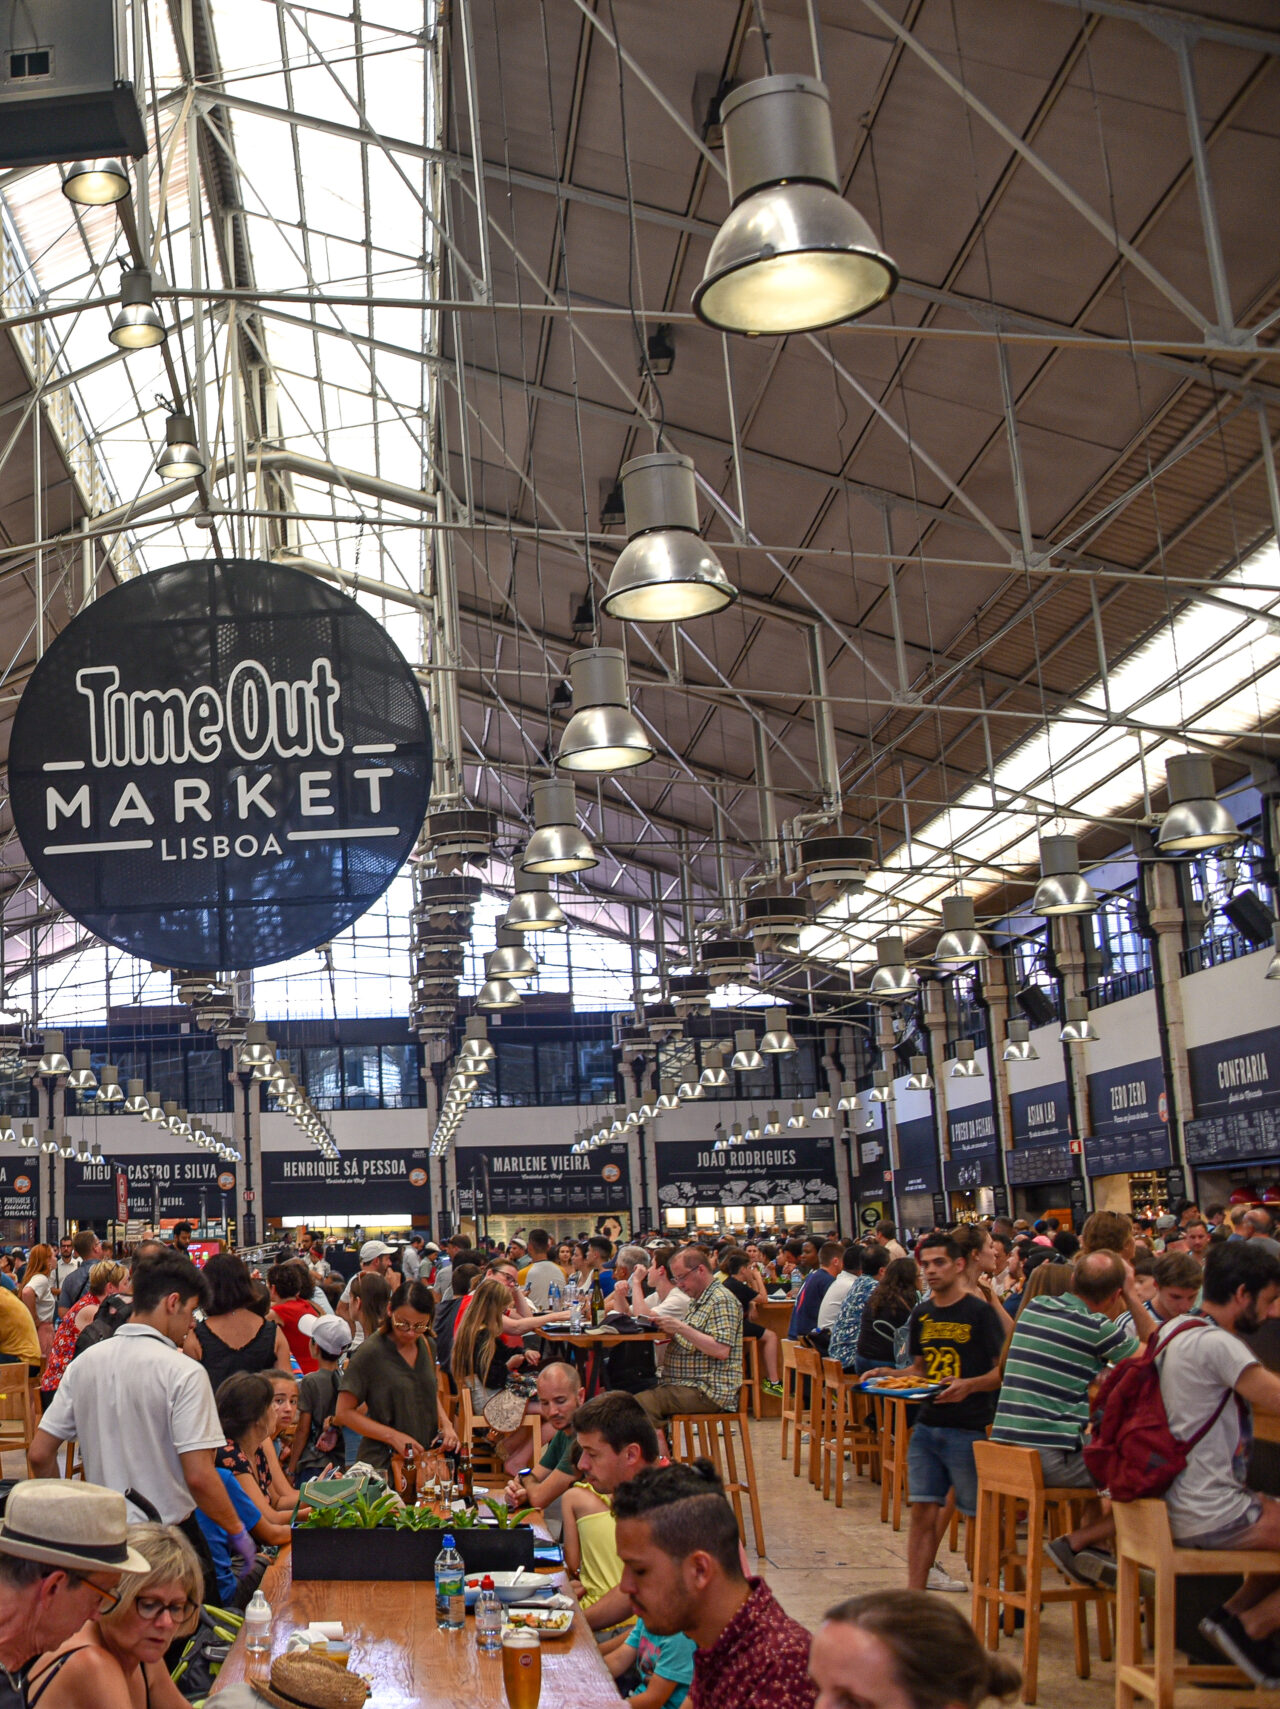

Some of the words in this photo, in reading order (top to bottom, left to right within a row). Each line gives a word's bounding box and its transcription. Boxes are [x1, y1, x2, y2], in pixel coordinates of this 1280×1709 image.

[47, 767, 394, 831] MARKET
[161, 832, 284, 862] LISBOA
[1217, 1052, 1269, 1089] CONFRARIA
[1110, 1085, 1128, 1110] ZERO
[1128, 1081, 1147, 1107] ZERO
[1044, 1101, 1056, 1124] LAB
[283, 1161, 340, 1177] HENRIQUE
[344, 1158, 359, 1176] SÁ
[363, 1159, 407, 1176] PESSOA
[493, 1156, 548, 1173] MARLENE
[551, 1155, 591, 1171] VIEIRA
[730, 1150, 797, 1166] RODRIGUES
[128, 1164, 170, 1179] CASTRO
[174, 1165, 181, 1179] E
[184, 1164, 217, 1179] SILVA
[922, 1347, 960, 1385] 23
